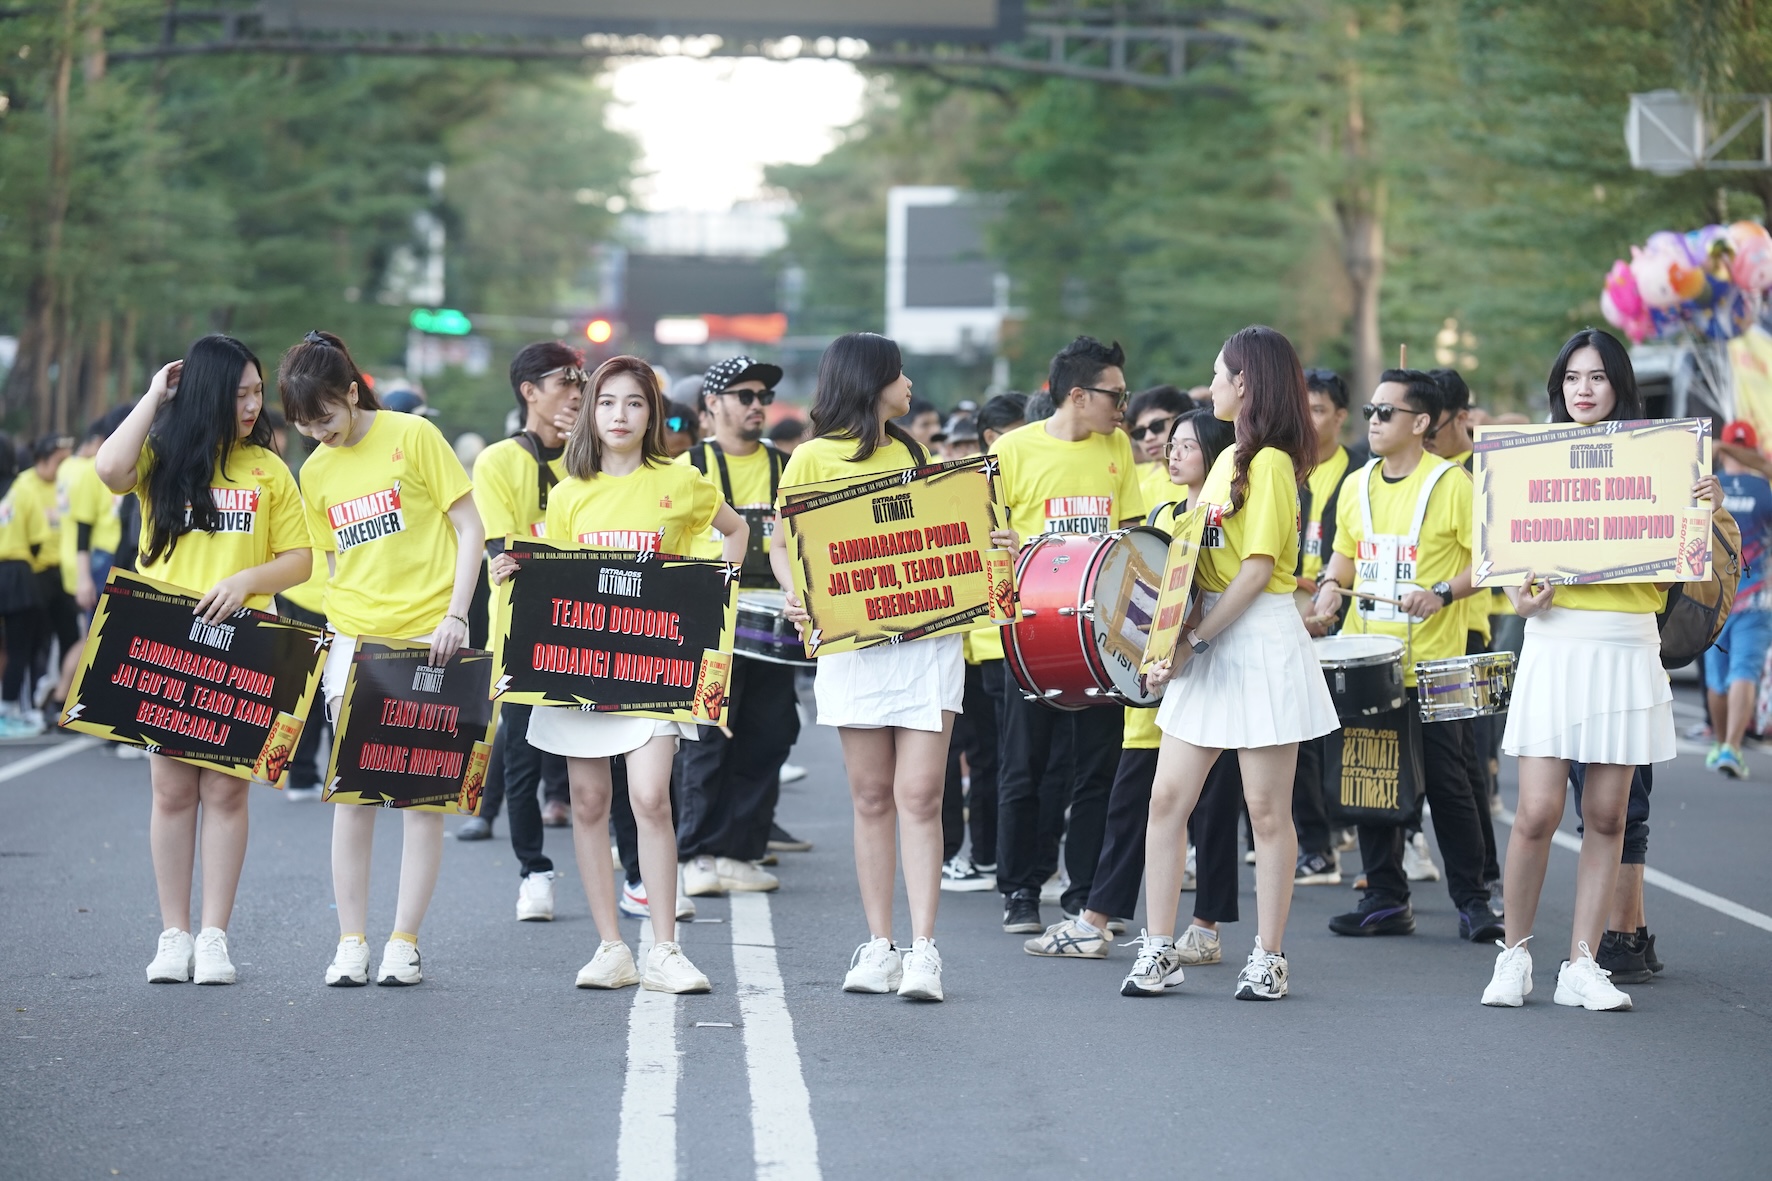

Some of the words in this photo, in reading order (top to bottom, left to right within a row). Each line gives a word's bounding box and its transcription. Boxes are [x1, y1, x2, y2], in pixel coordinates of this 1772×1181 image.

[1570, 443, 1613, 451] EXTRAJOSS
[1570, 449, 1614, 469] ULTIMATE
[872, 493, 911, 505] EXTRAJOSS
[1050, 497, 1109, 517] ULTIMATE
[1528, 477, 1599, 503] MENTENG
[1604, 476, 1655, 504] KONAI,
[330, 489, 395, 528] ULTIMATE
[872, 499, 915, 524] ULTIMATE
[337, 512, 401, 550] TAKEOVER
[828, 529, 923, 565] GAMMARAKKO
[924, 521, 971, 550] PUNNA
[1510, 517, 1599, 543] NGONDANGI
[1603, 515, 1674, 540] MIMPINU
[1677, 517, 1688, 574] EXTRAJOSS
[532, 552, 545, 560] TIDAK
[600, 567, 642, 578] EXTRAJOSS
[828, 571, 851, 596] JAI
[902, 556, 945, 584] TEAKO
[945, 549, 983, 577] KANA
[597, 573, 642, 598] ULTIMATE
[986, 559, 997, 619] EXTRAJOSS
[865, 585, 954, 621] BERENCANAJI
[188, 621, 235, 652] ULTIMATE
[551, 598, 605, 631] TEAKO
[608, 605, 684, 646] DODONG,
[128, 635, 229, 684] GAMMARAKKO
[226, 664, 275, 699] PUNNA
[412, 671, 444, 693] ULTIMATE
[416, 665, 445, 674] EXTRAJOSS
[532, 642, 610, 678] ONDANGI
[612, 652, 694, 689] MIMPINU
[111, 663, 139, 689] JAI
[190, 684, 236, 717] TEAKO
[233, 697, 274, 729] KANA
[693, 658, 708, 716] EXTRAJOSS
[136, 700, 231, 747] BERENCANAJI
[381, 698, 419, 729] TEAKO
[418, 703, 459, 738] KUTTU,
[1343, 727, 1398, 740] EXTRAJOSS
[253, 721, 281, 775] EXTRAJOSS
[359, 742, 409, 773] ONDANG
[407, 747, 464, 779] MIMPINU
[1341, 737, 1400, 769] ULTIMATE
[1341, 767, 1399, 779] EXTRAJOSS
[1341, 776, 1400, 810] ULTIMATE
